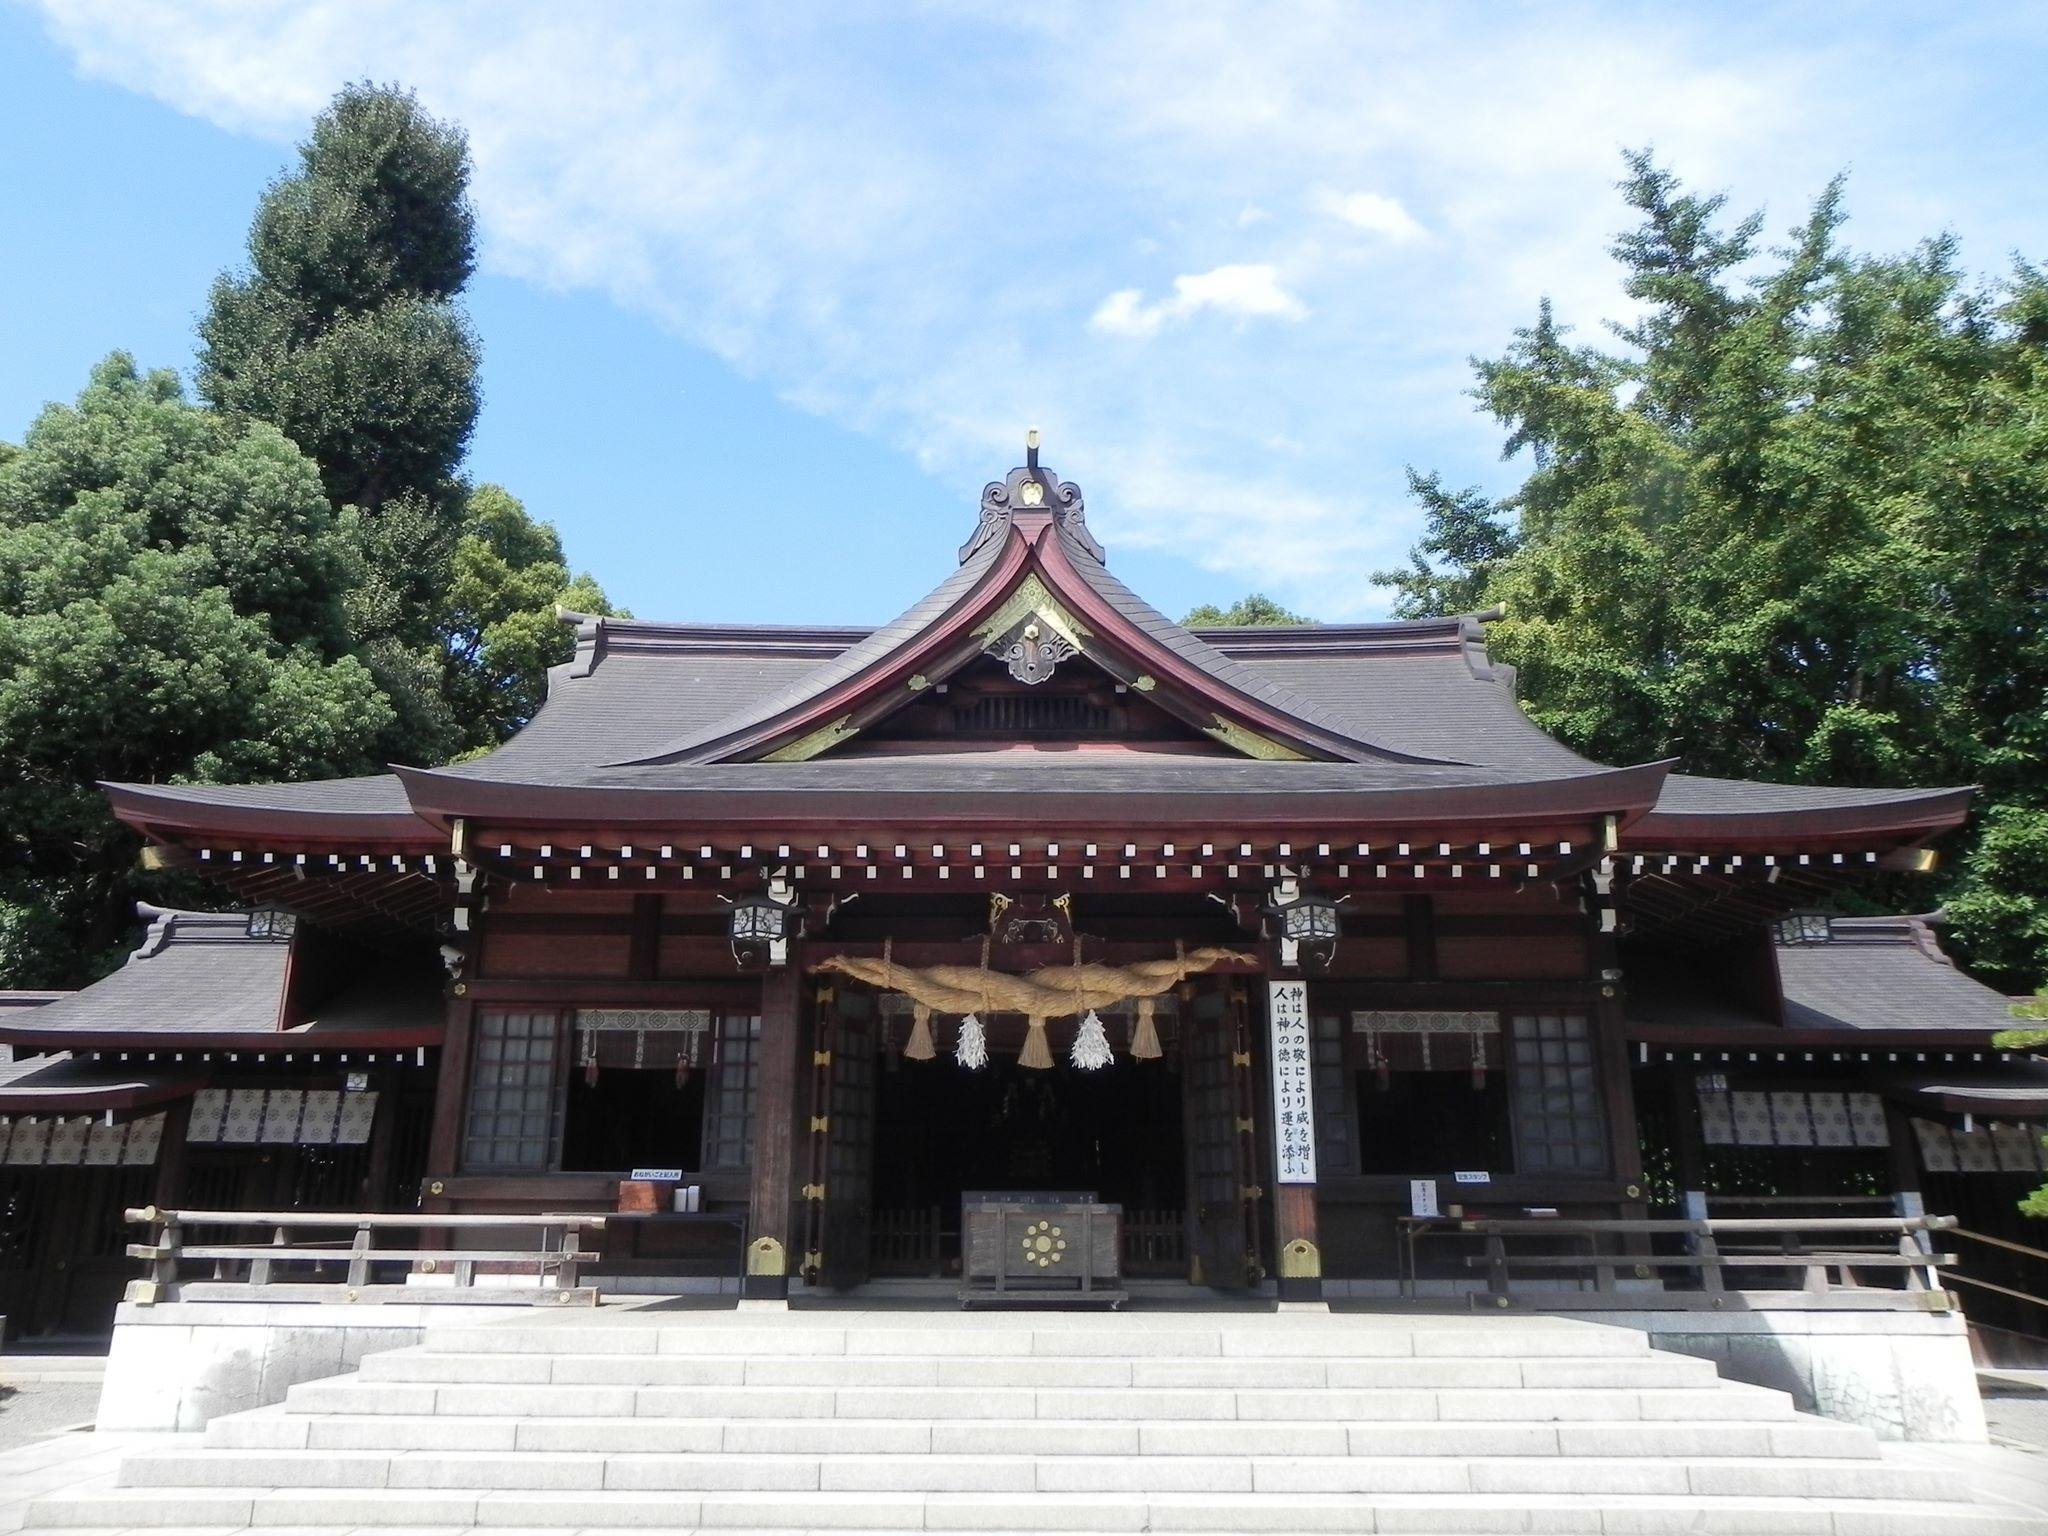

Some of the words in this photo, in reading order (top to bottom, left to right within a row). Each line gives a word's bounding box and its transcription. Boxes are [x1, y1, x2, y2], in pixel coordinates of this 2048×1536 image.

[1274, 987, 1296, 1175] 人は神の徳により運を添ふ
[1289, 987, 1311, 1175] 神は人の敬により威を増し
